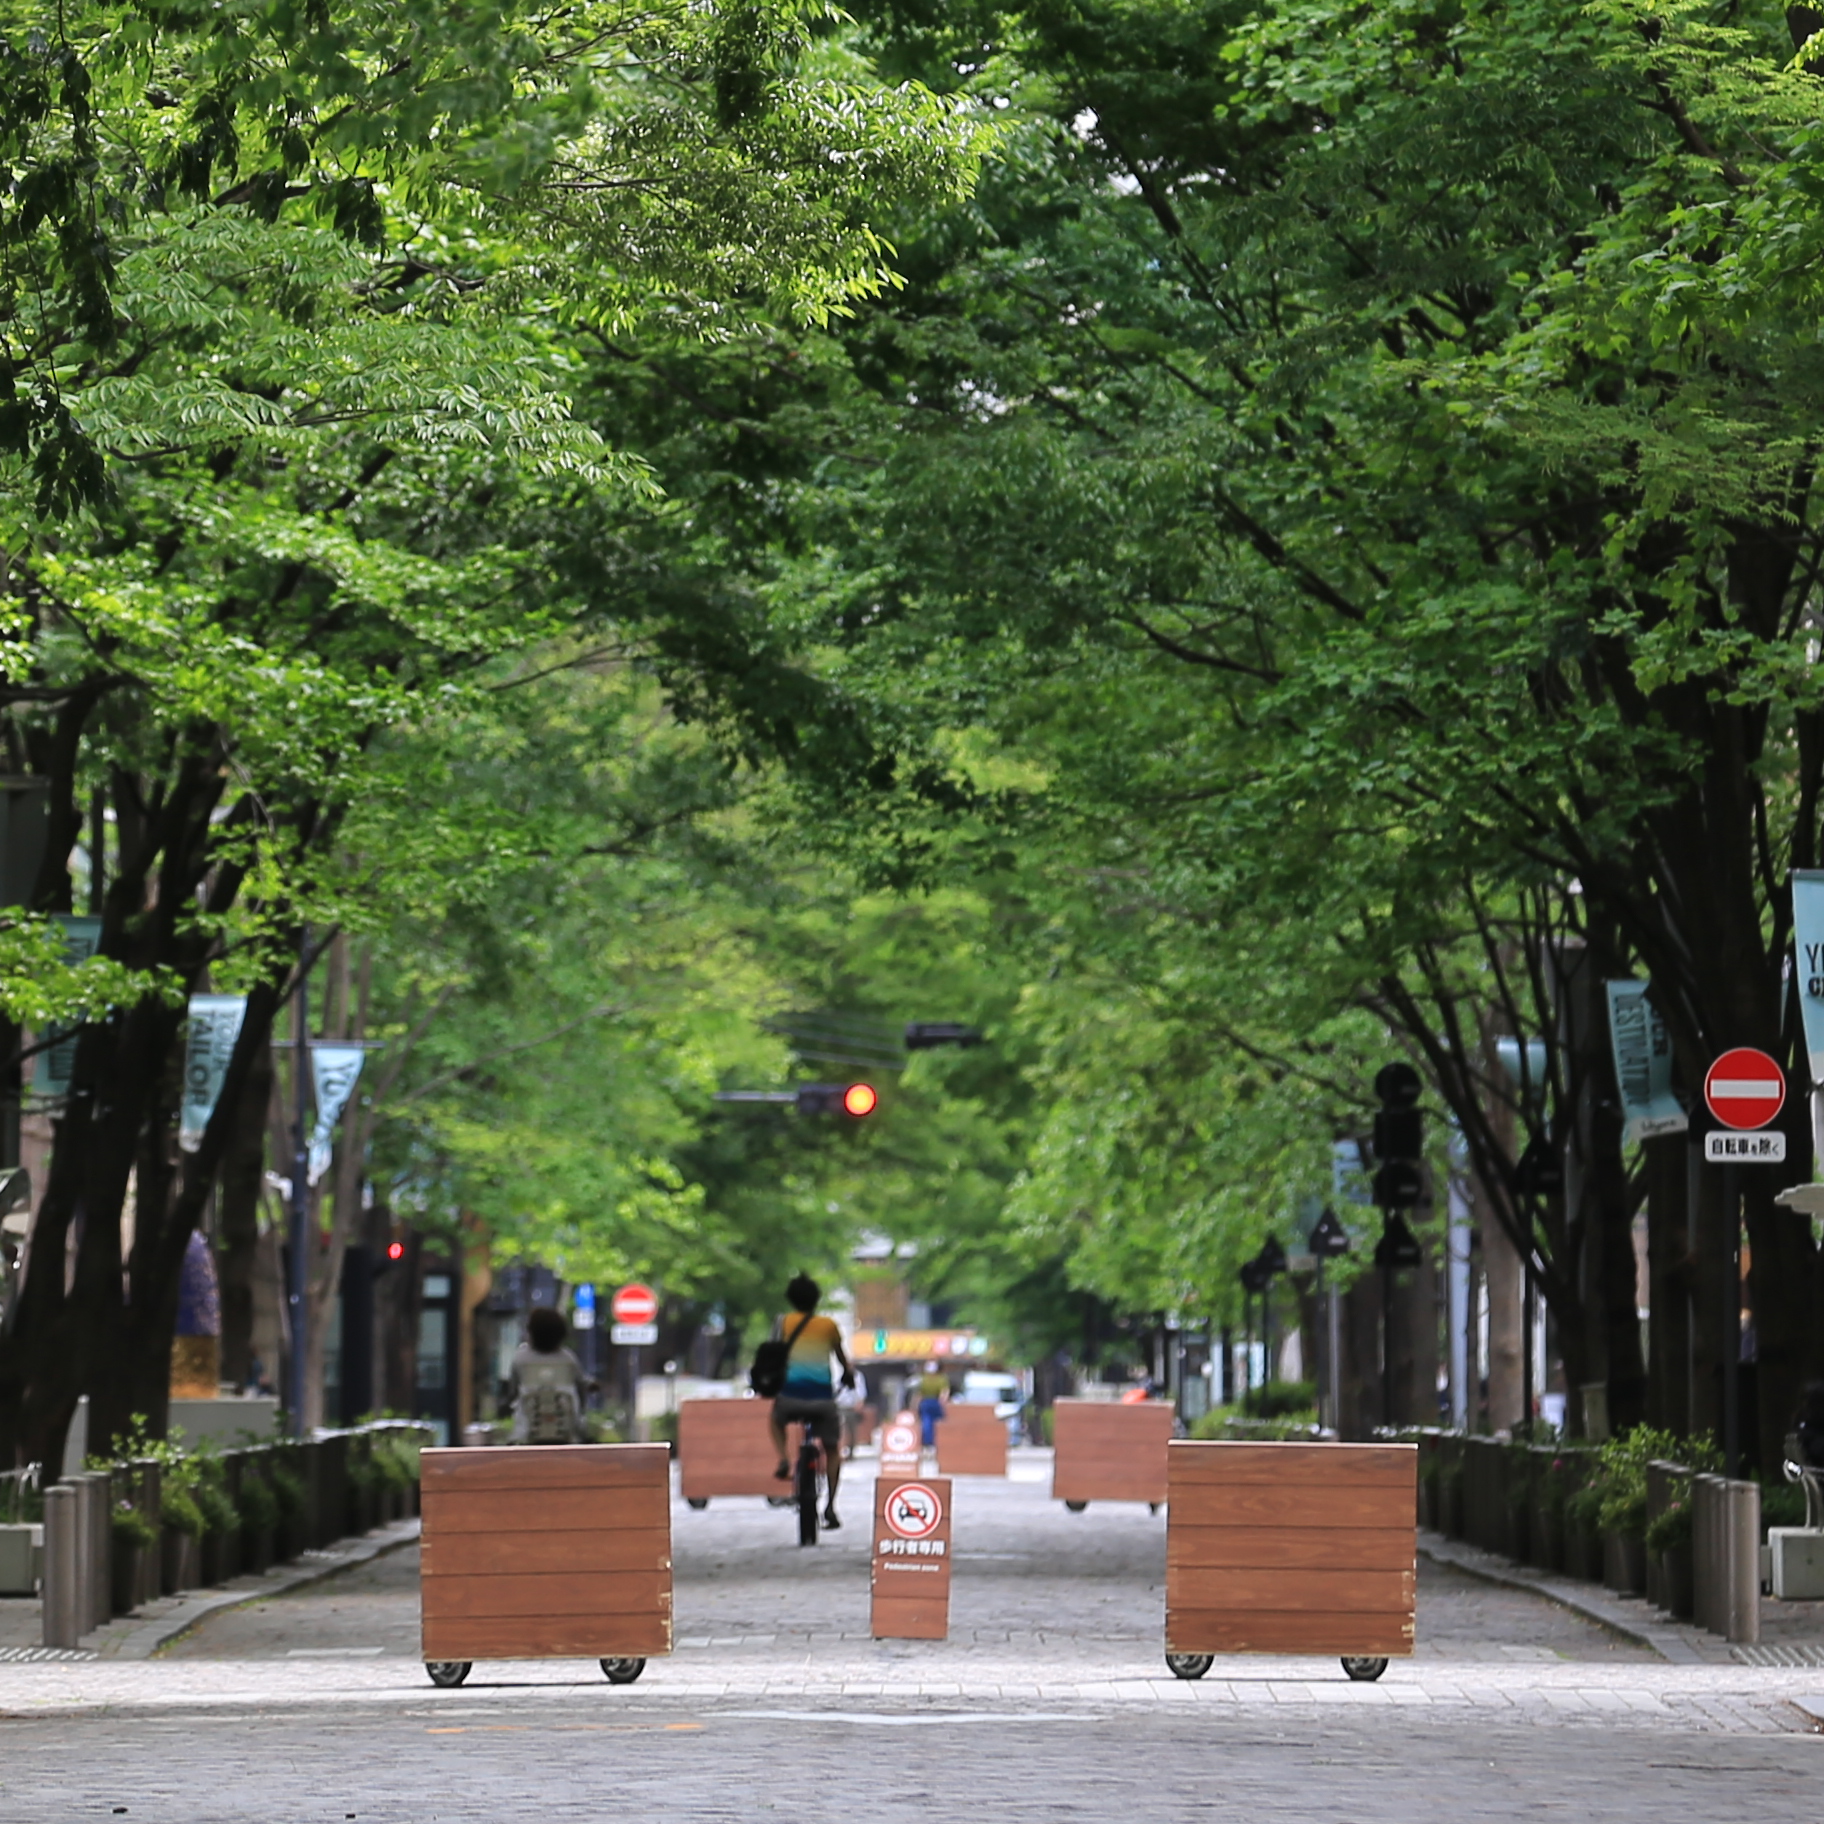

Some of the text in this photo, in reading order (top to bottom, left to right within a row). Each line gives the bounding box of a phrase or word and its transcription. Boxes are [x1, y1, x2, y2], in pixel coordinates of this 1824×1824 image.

[879, 1538, 946, 1556] 歩行者専用
